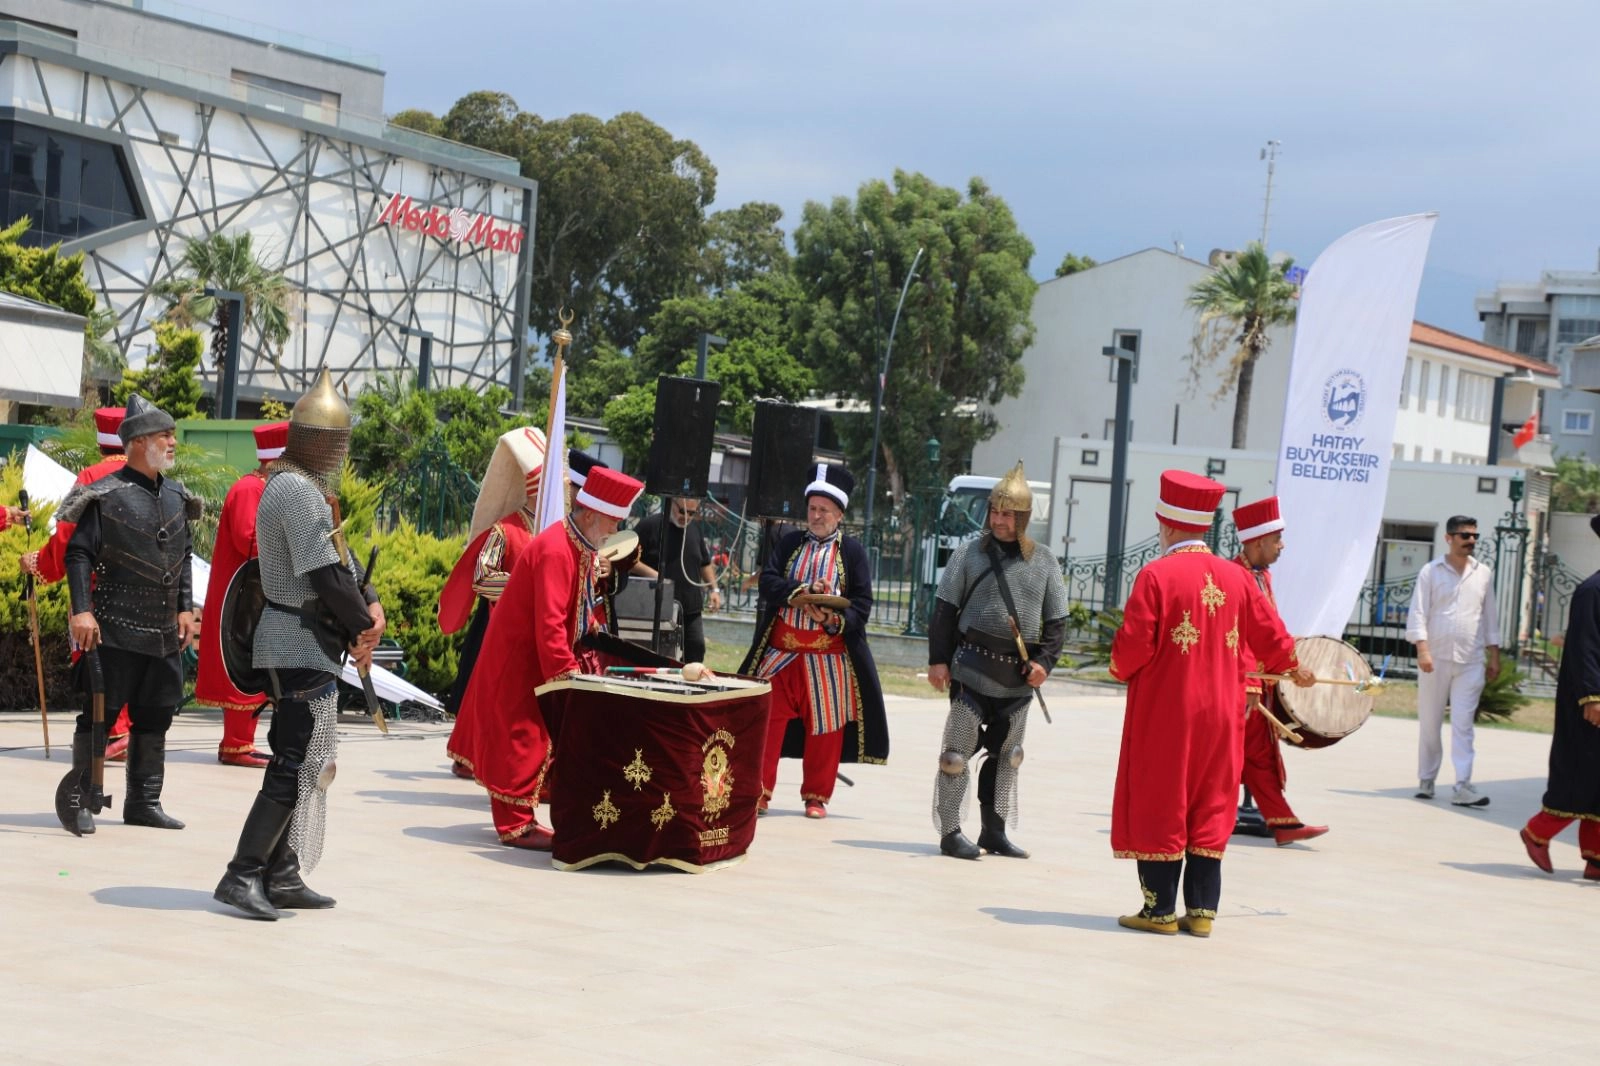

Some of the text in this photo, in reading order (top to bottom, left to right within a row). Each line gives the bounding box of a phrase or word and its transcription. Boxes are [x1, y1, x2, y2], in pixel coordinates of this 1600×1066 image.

[376, 192, 525, 254] Media Markt
[1312, 433, 1364, 450] HATAY
